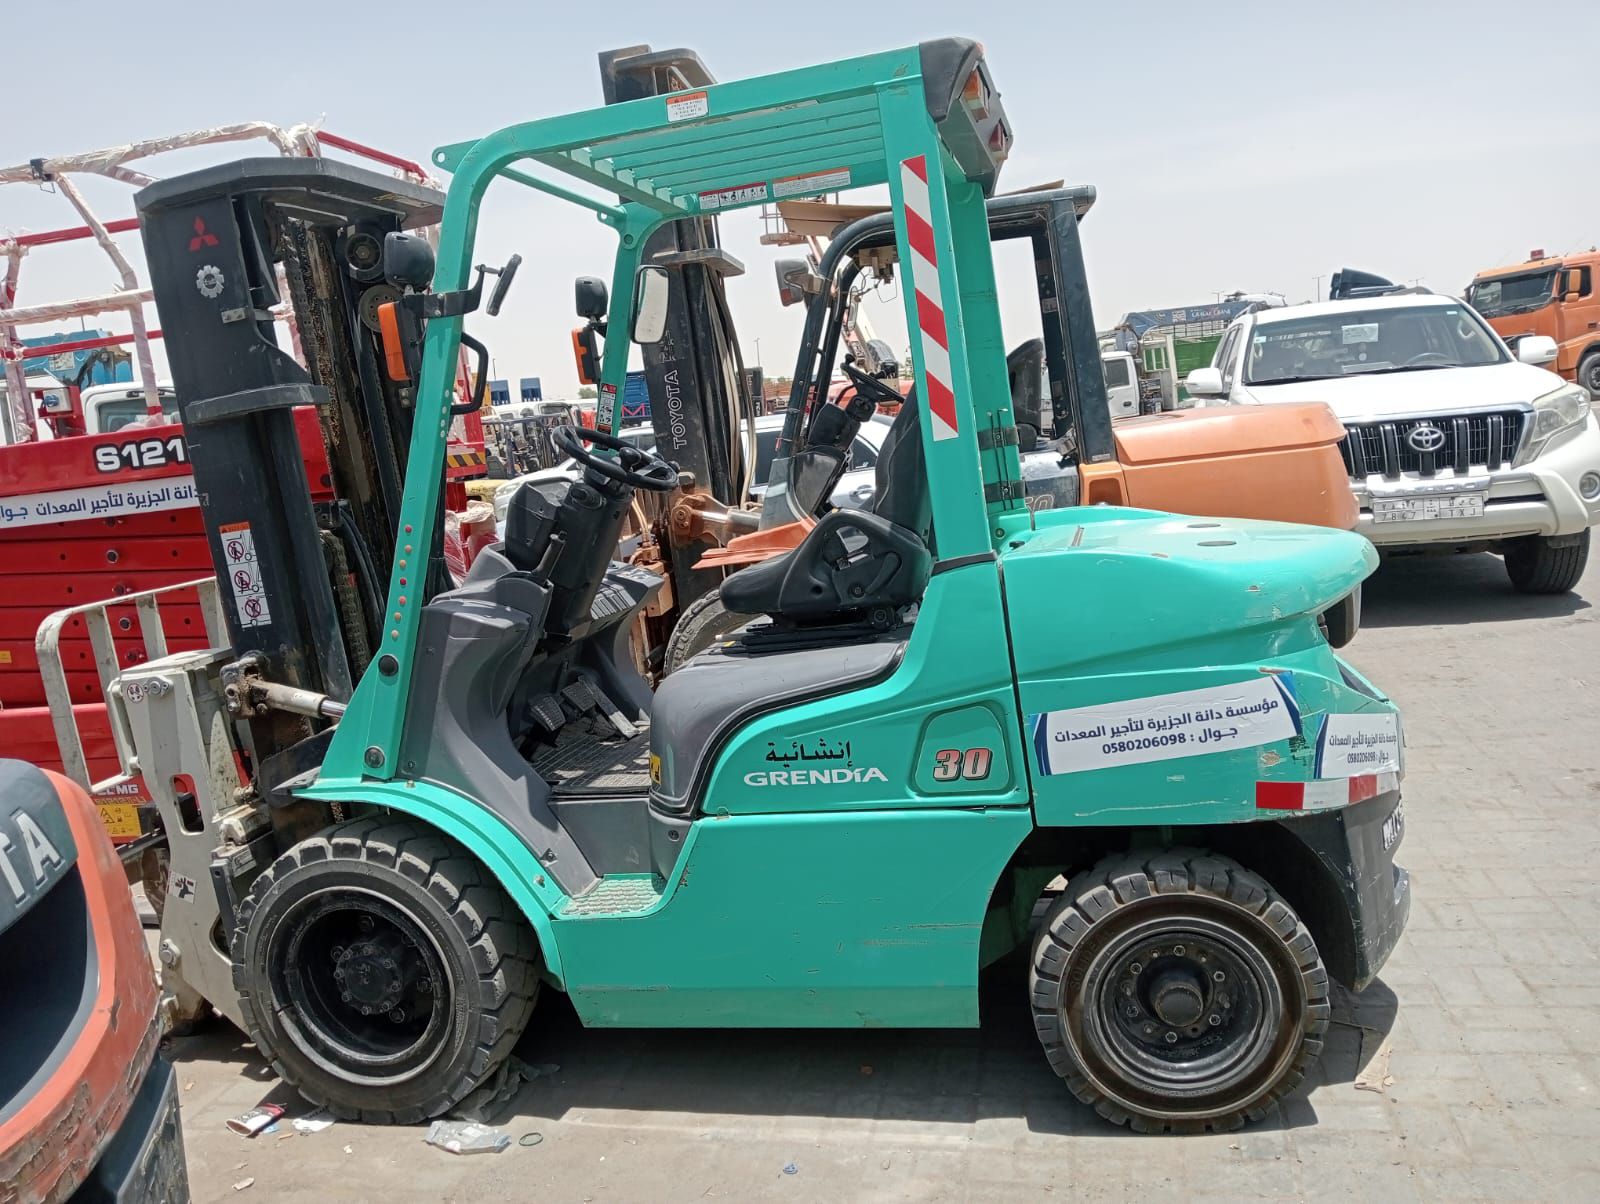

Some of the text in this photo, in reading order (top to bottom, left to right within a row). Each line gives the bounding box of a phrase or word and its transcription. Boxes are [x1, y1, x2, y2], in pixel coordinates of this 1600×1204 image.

[665, 370, 687, 449] TOYOTA
[36, 498, 86, 516] المعدات
[91, 490, 123, 514] لتأجير
[127, 487, 170, 509] الجزيرة
[1055, 698, 1279, 742] مؤسسة دانة الجزيرة لتأجير المعدات
[765, 738, 853, 768] إنشائية
[1102, 732, 1187, 755] 0580206098
[933, 748, 993, 782] 30
